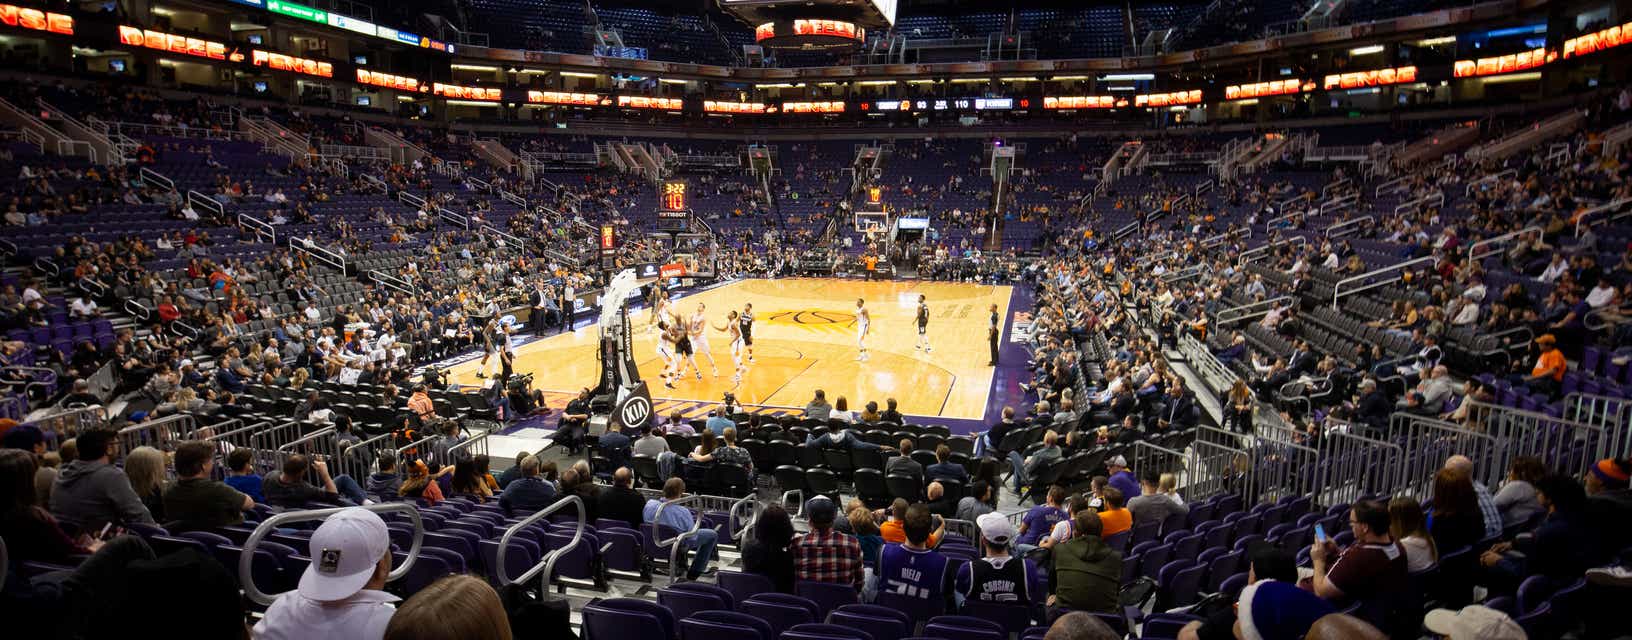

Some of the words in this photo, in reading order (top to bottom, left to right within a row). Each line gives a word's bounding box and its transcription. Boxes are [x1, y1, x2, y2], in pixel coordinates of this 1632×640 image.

[954, 100, 969, 109] 110
[665, 183, 685, 194] 3:22
[669, 194, 682, 210] 10
[625, 401, 647, 424] KIA
[982, 580, 1016, 593] COUSINS
